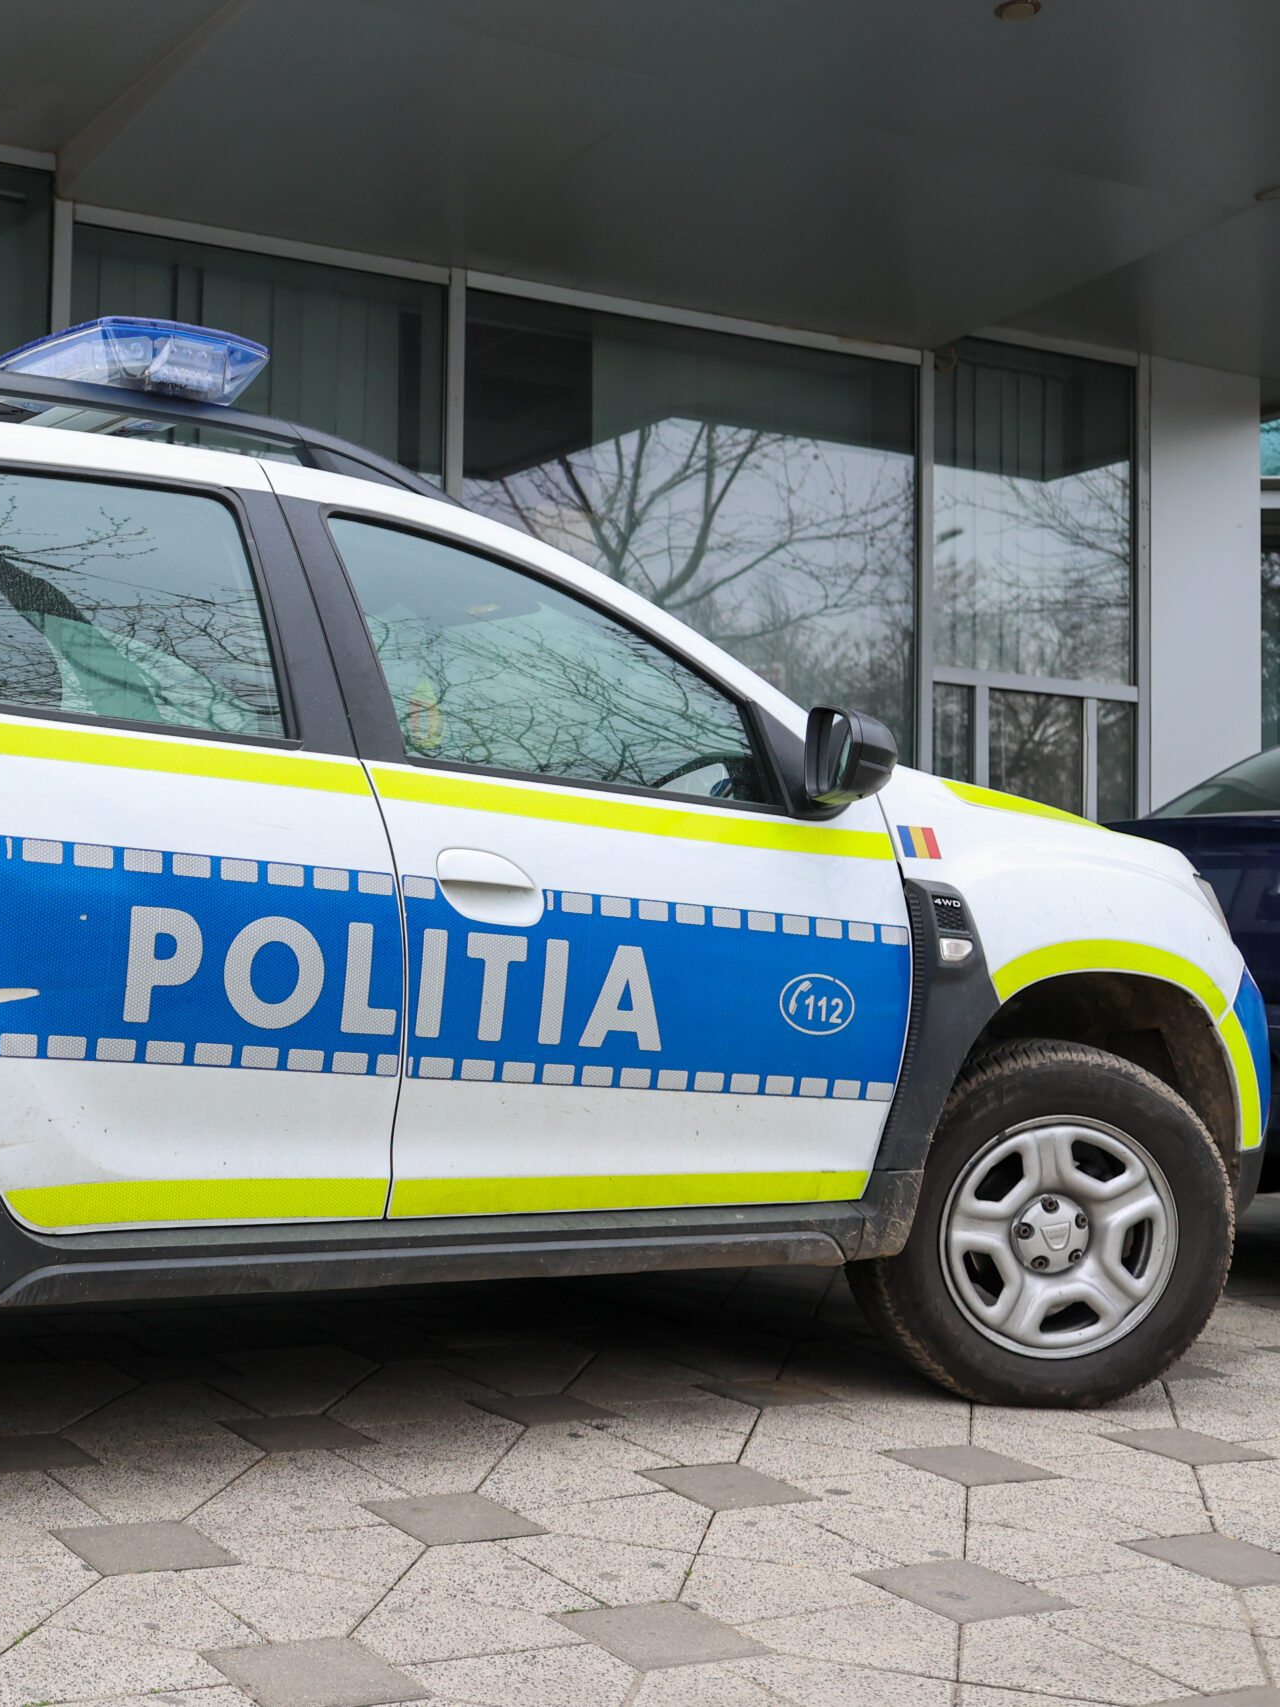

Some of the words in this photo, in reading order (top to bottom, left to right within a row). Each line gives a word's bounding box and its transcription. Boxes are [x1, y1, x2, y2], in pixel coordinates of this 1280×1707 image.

[934, 898, 961, 908] 4WD
[122, 905, 662, 1051] POLITIA
[805, 994, 844, 1024] 112
